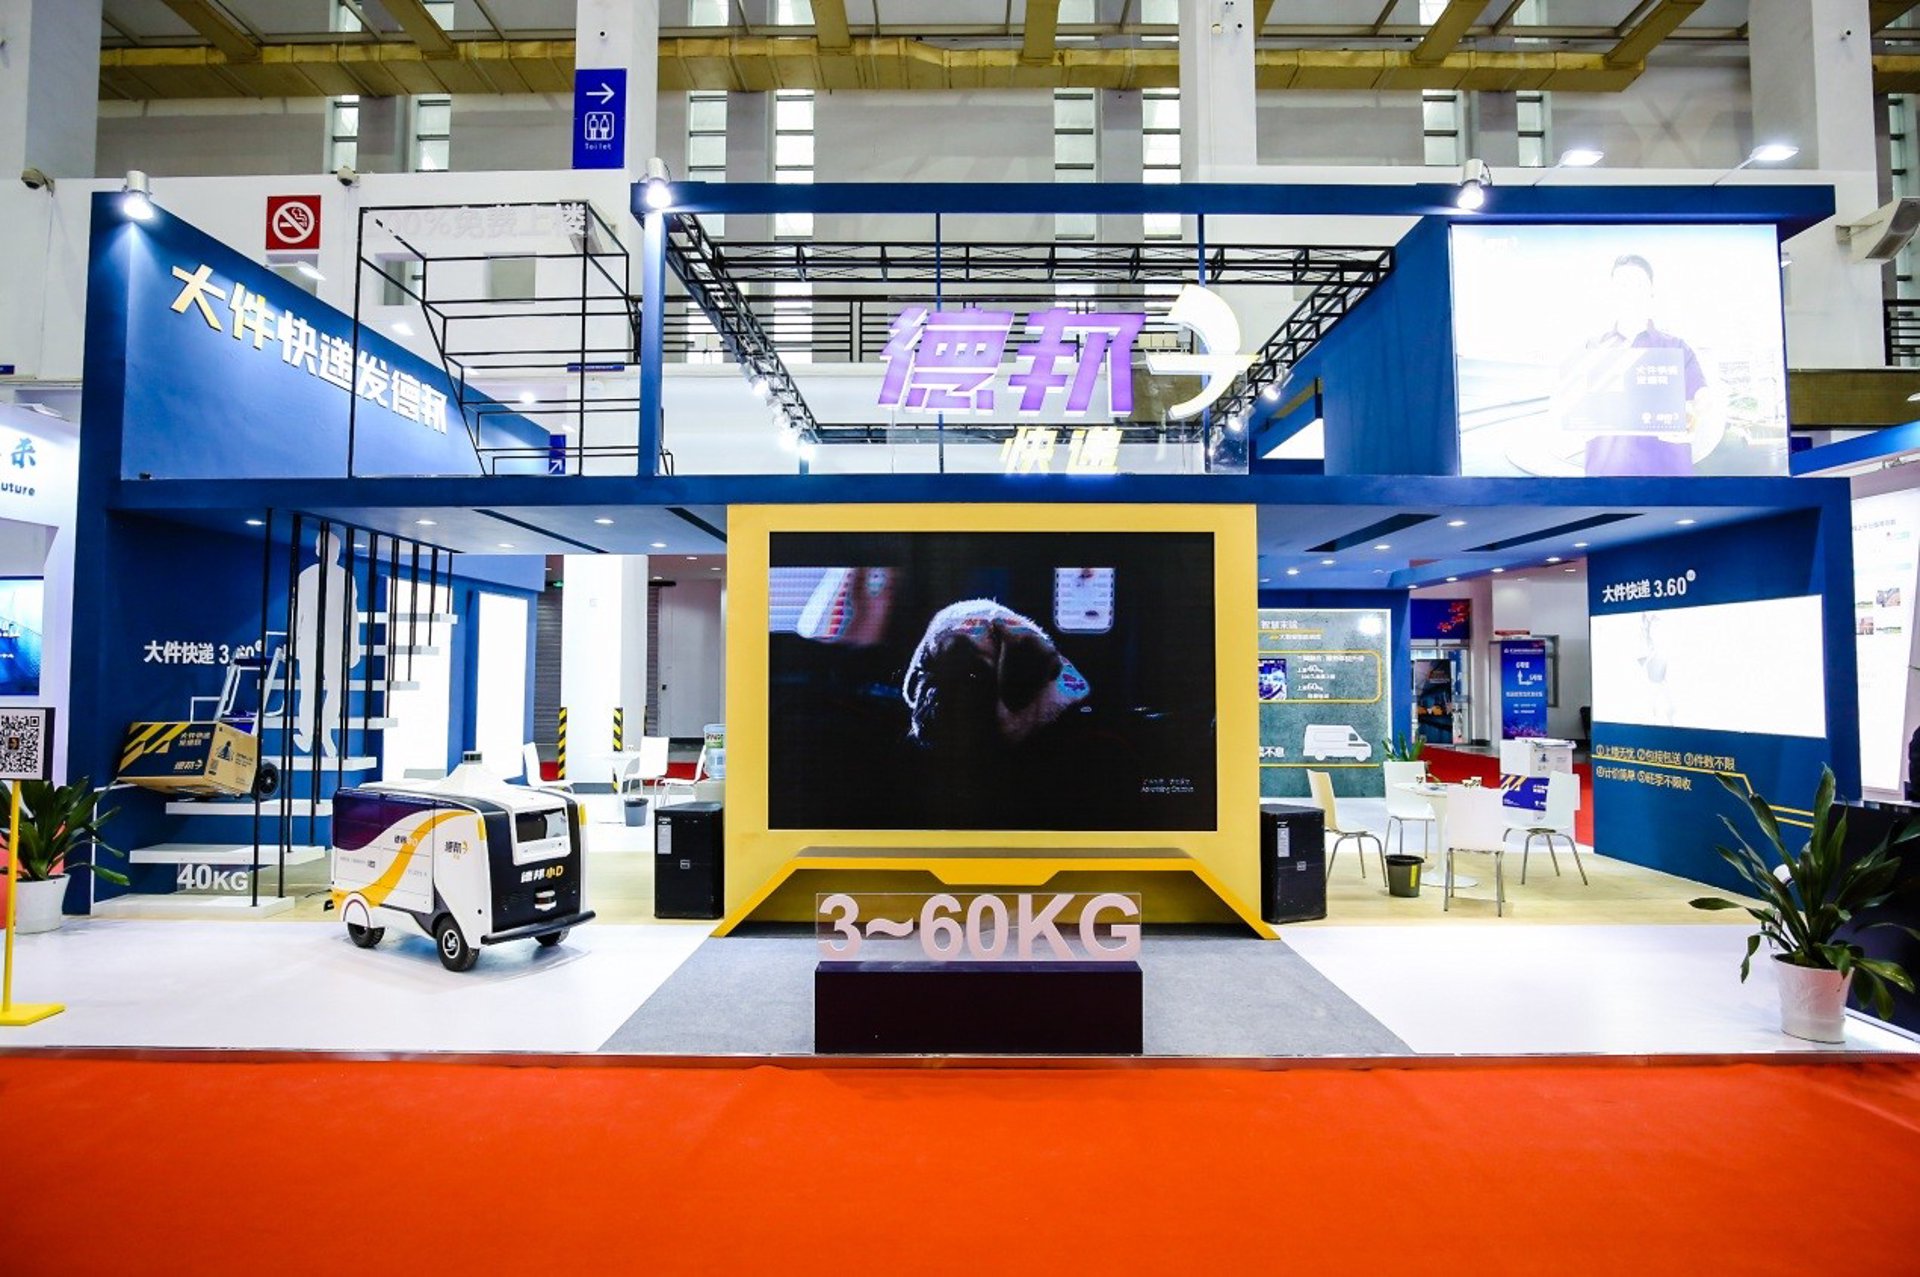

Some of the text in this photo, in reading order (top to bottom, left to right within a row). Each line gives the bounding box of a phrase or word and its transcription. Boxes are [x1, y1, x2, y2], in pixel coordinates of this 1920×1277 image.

[585, 142, 611, 150] Toilet
[170, 264, 448, 434] 大件快递发德邦
[878, 307, 1146, 417] 德邦
[1000, 426, 1122, 474] 快递
[0, 482, 35, 496] uture
[1602, 578, 1651, 603] 大件快递
[144, 640, 215, 664] 大件快递
[177, 863, 249, 891] 40KG
[520, 865, 564, 883] 德邦小D
[818, 893, 1140, 961] 3~60KG
